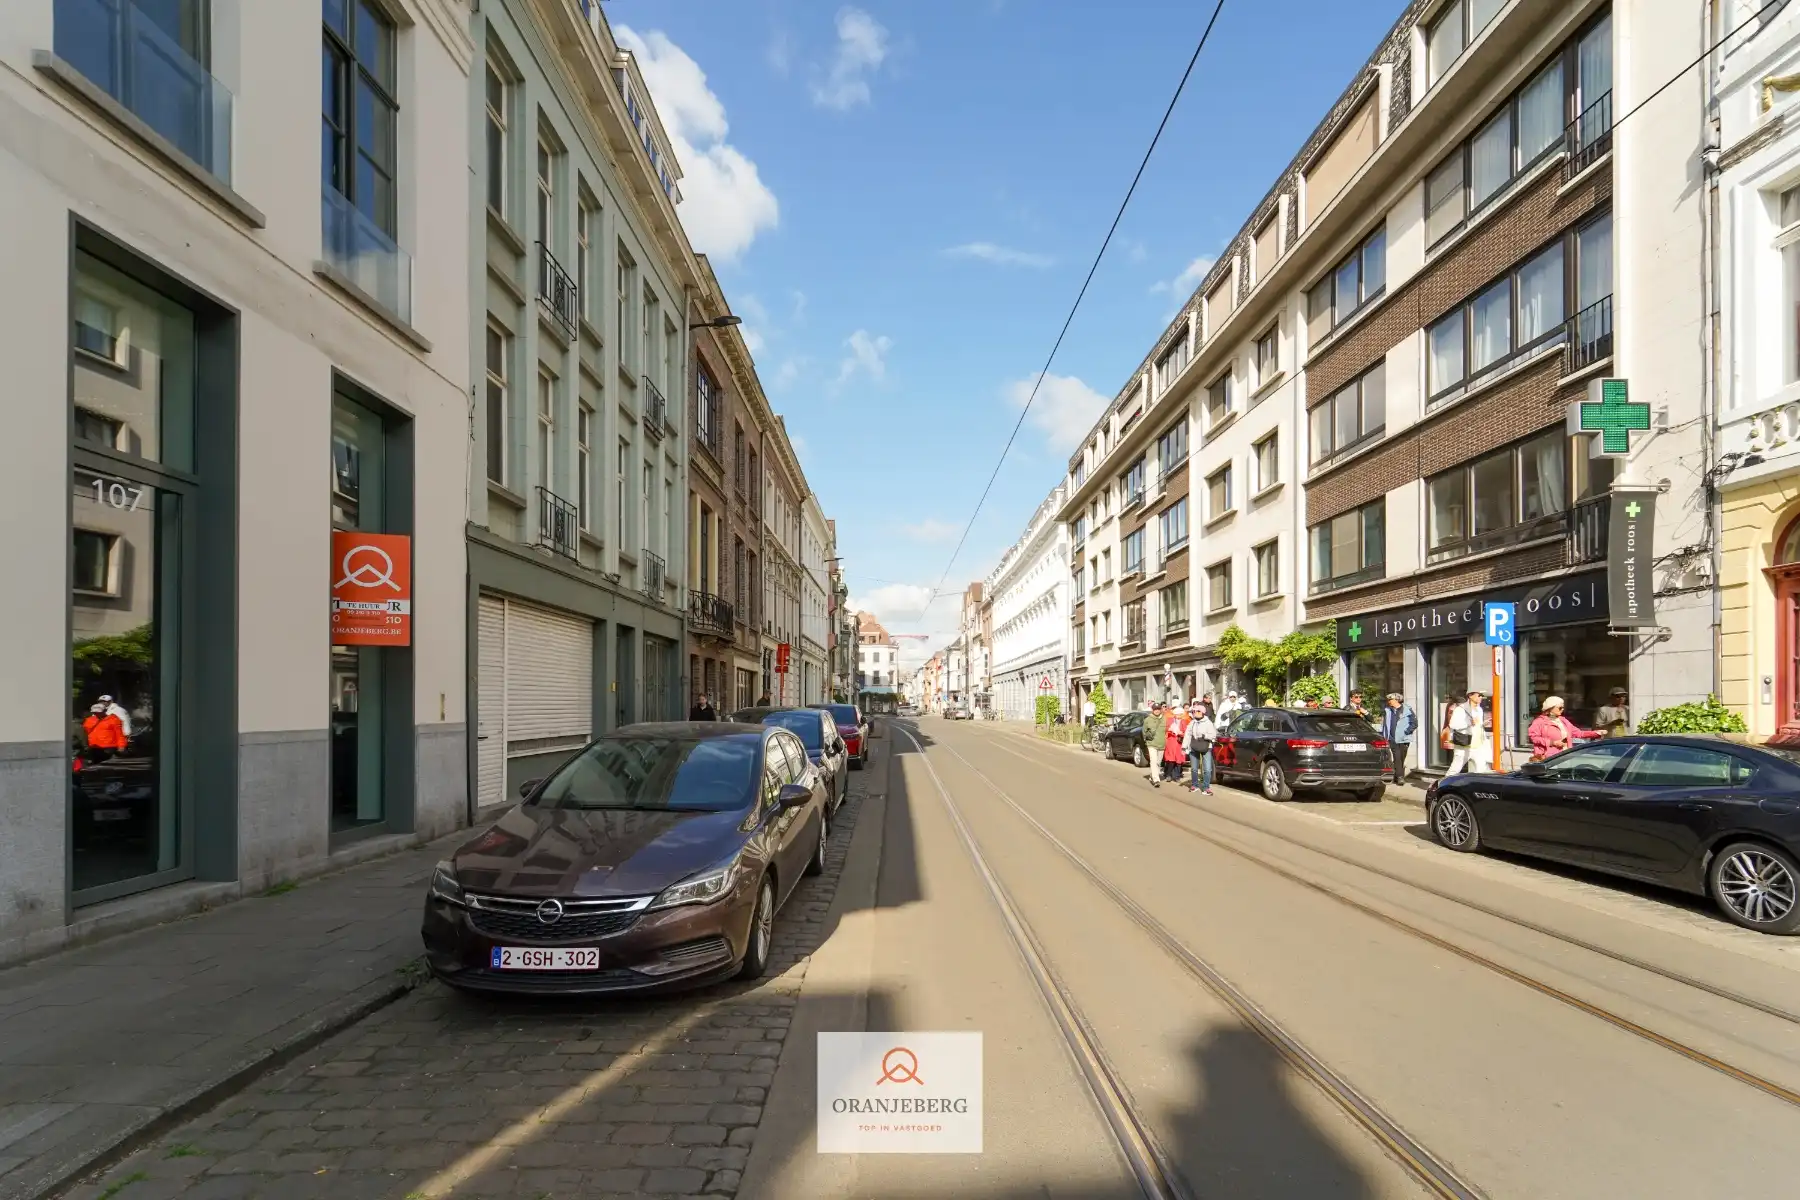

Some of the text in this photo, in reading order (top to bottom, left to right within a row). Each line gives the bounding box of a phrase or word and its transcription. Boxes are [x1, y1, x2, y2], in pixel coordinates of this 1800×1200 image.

[92, 479, 143, 512] 107
[332, 627, 402, 635] ORANJEBERG.BE
[1489, 607, 1509, 637] P
